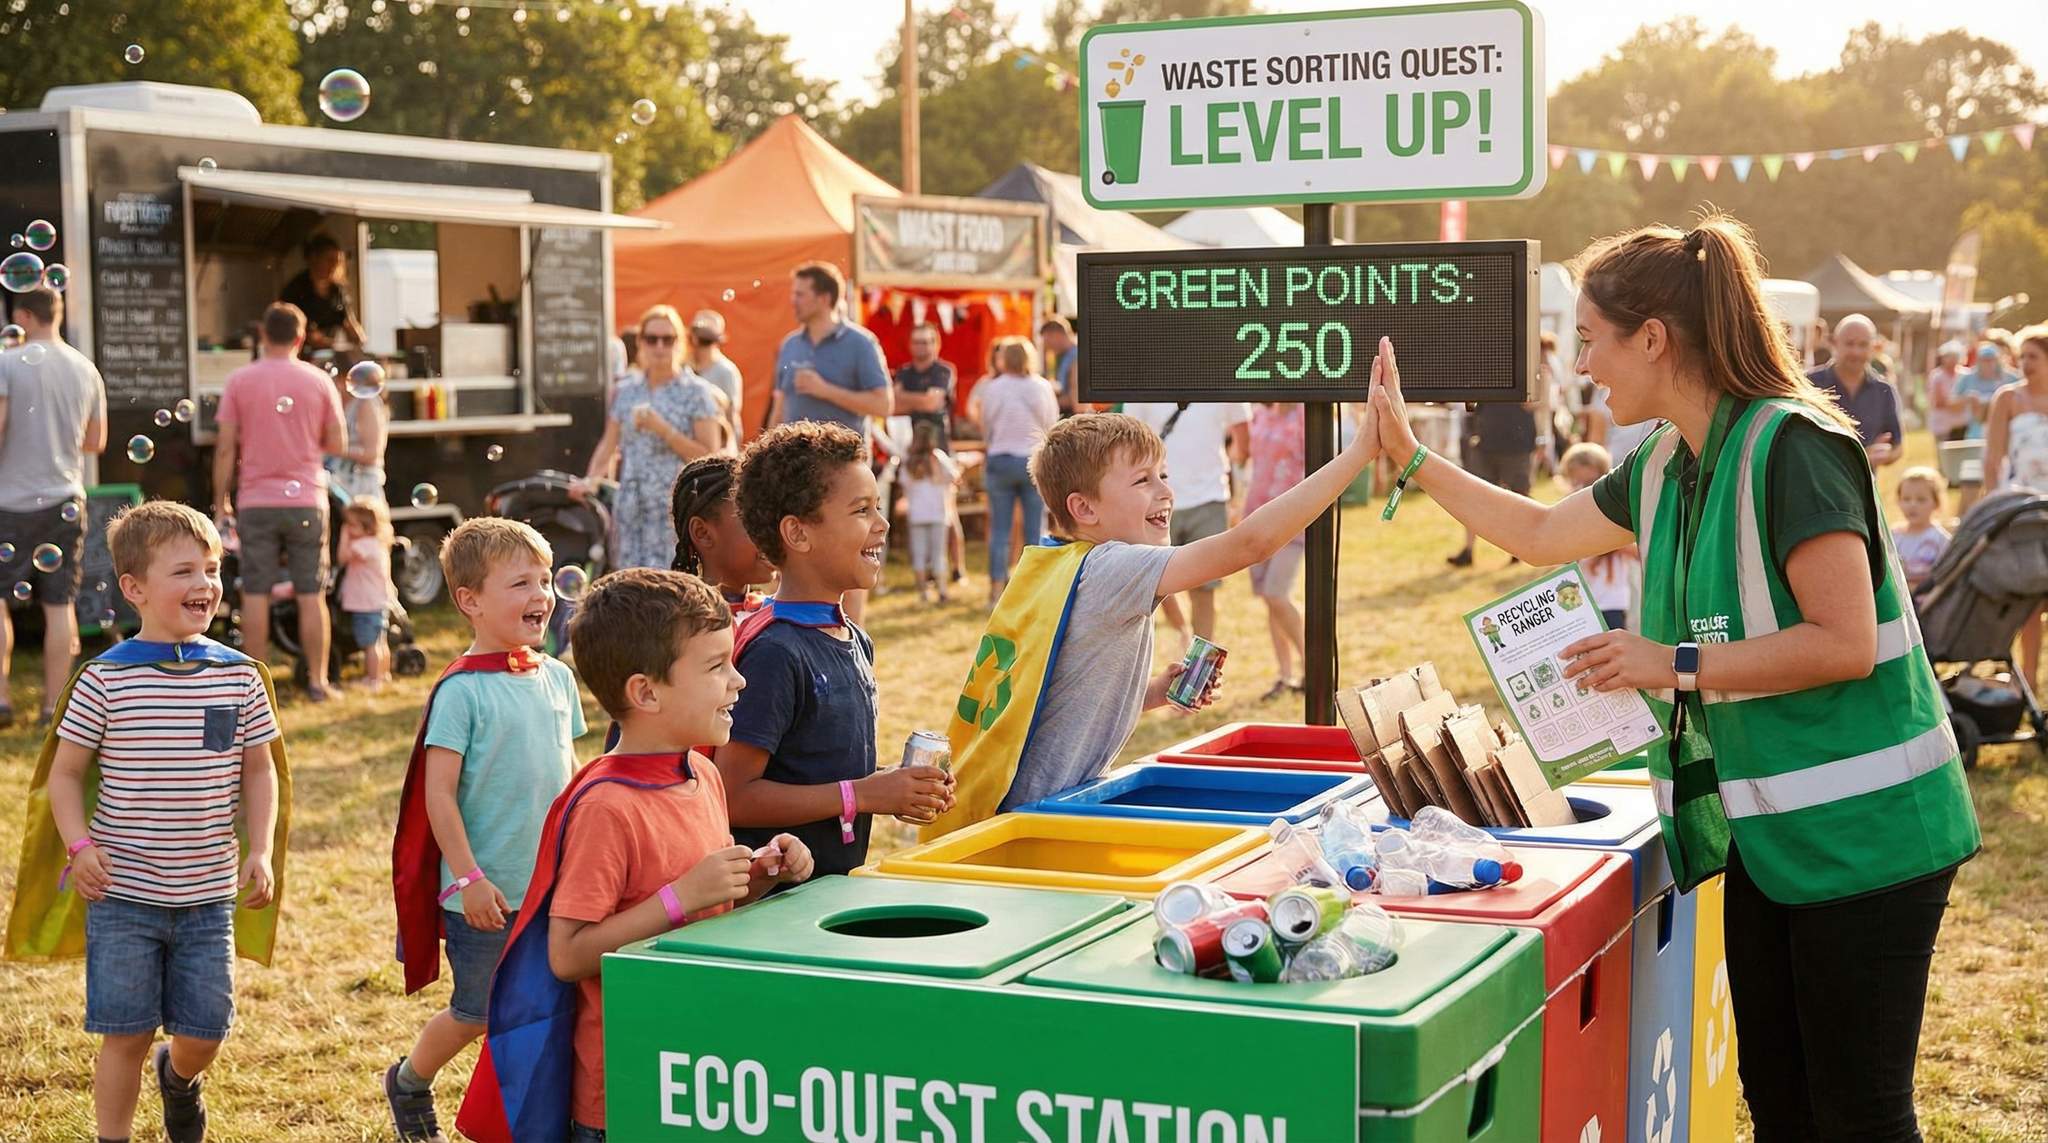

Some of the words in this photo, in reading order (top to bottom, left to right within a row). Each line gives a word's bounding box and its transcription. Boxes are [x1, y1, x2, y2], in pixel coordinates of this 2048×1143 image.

[1161, 58, 1258, 91] WASTE
[1266, 50, 1391, 86] SORTING
[1400, 44, 1503, 81] QUEST:
[1170, 97, 1362, 166] LEVEL
[1386, 89, 1492, 158] UP!
[1116, 267, 1268, 309] GREEN
[1286, 262, 1474, 306] POINTS:
[1235, 321, 1353, 380] 250
[1497, 589, 1556, 626] RECYCLING
[1511, 607, 1556, 637] RANGER
[659, 1050, 996, 1143] ECO-QUEST
